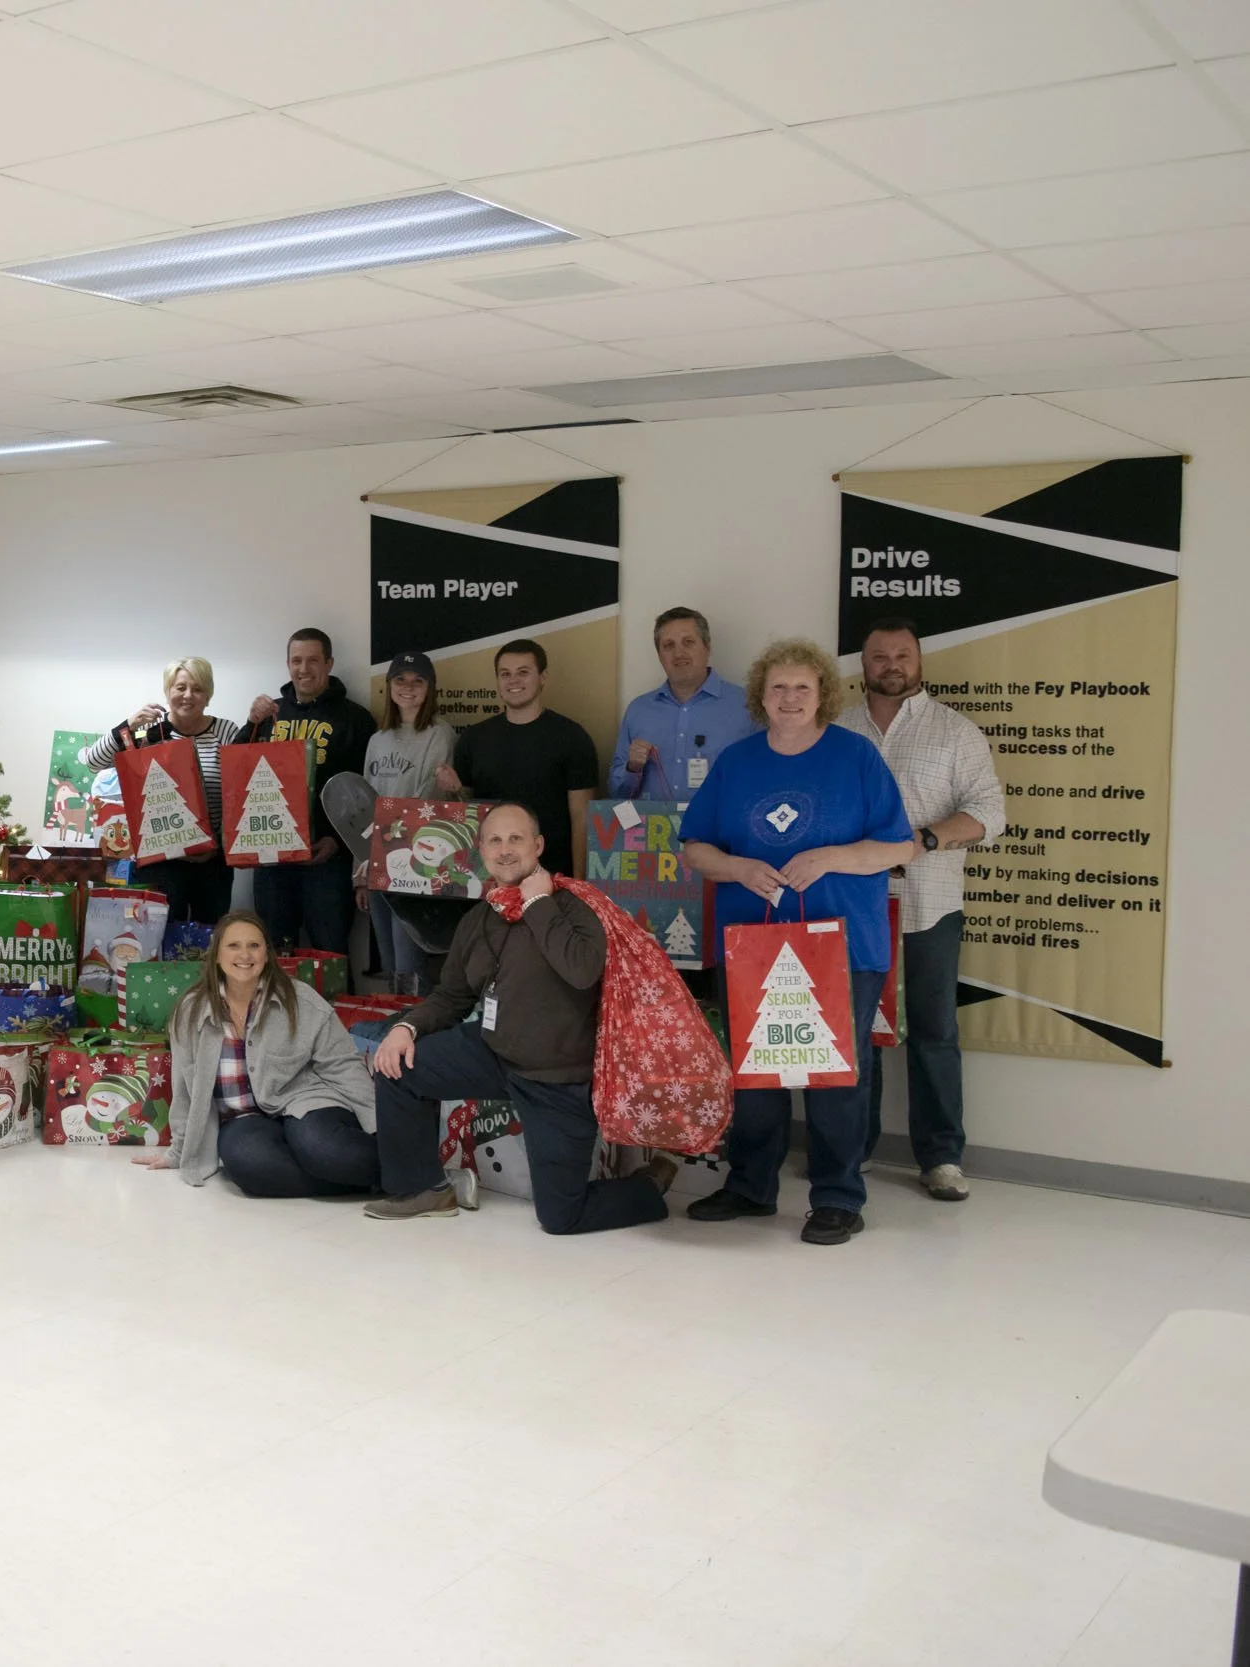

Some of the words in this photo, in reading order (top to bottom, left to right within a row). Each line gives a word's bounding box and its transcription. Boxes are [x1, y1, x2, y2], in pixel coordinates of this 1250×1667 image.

[851, 547, 930, 569] Drive
[377, 580, 436, 599] Team
[443, 579, 519, 601] Player
[851, 575, 961, 598] Results
[446, 690, 464, 698] our
[466, 688, 497, 698] entire
[973, 682, 1003, 695] with
[1007, 682, 1030, 695] the
[1034, 681, 1064, 698] Fey
[1070, 681, 1150, 698] Playbook
[482, 704, 500, 714] we
[270, 719, 334, 747] SWC
[1032, 725, 1072, 738] tasks
[1075, 725, 1104, 738] that
[998, 742, 1067, 755] success
[1071, 743, 1088, 755] of
[1091, 743, 1115, 756] the
[151, 781, 168, 791] THE
[255, 780, 274, 788] THE
[1006, 784, 1023, 796] be
[1028, 784, 1064, 797] done
[1069, 786, 1097, 798] and
[1101, 786, 1145, 799] drive
[147, 791, 178, 806] SEASON
[250, 792, 281, 803] SEASON
[156, 805, 174, 815] FOR
[256, 805, 275, 814] FOR
[151, 813, 184, 834] BIG
[250, 814, 283, 831] BIG
[145, 827, 198, 849] PRESENTS!
[240, 832, 294, 847] PRESENTS!
[999, 825, 1028, 840] kly
[1034, 826, 1065, 839] and
[1071, 829, 1150, 846] correctly
[1005, 844, 1045, 856] result
[996, 867, 1012, 880] by
[1017, 868, 1071, 884] making
[1075, 869, 1159, 886] decisions
[1025, 893, 1052, 906] and
[1057, 893, 1115, 909] deliver
[1121, 900, 1143, 911] on
[1148, 898, 1161, 912] it
[997, 915, 1010, 927] of
[1015, 917, 1099, 933] problems...
[961, 931, 987, 943] that
[992, 933, 1036, 946] avoid
[1041, 935, 1080, 949] fires
[775, 976, 801, 985] THE
[767, 992, 811, 1006] SEASON
[778, 1010, 803, 1019] FOR
[767, 1023, 815, 1045] BIG
[754, 1048, 830, 1065] PRESENTS!
[472, 1111, 510, 1137] SNOW
